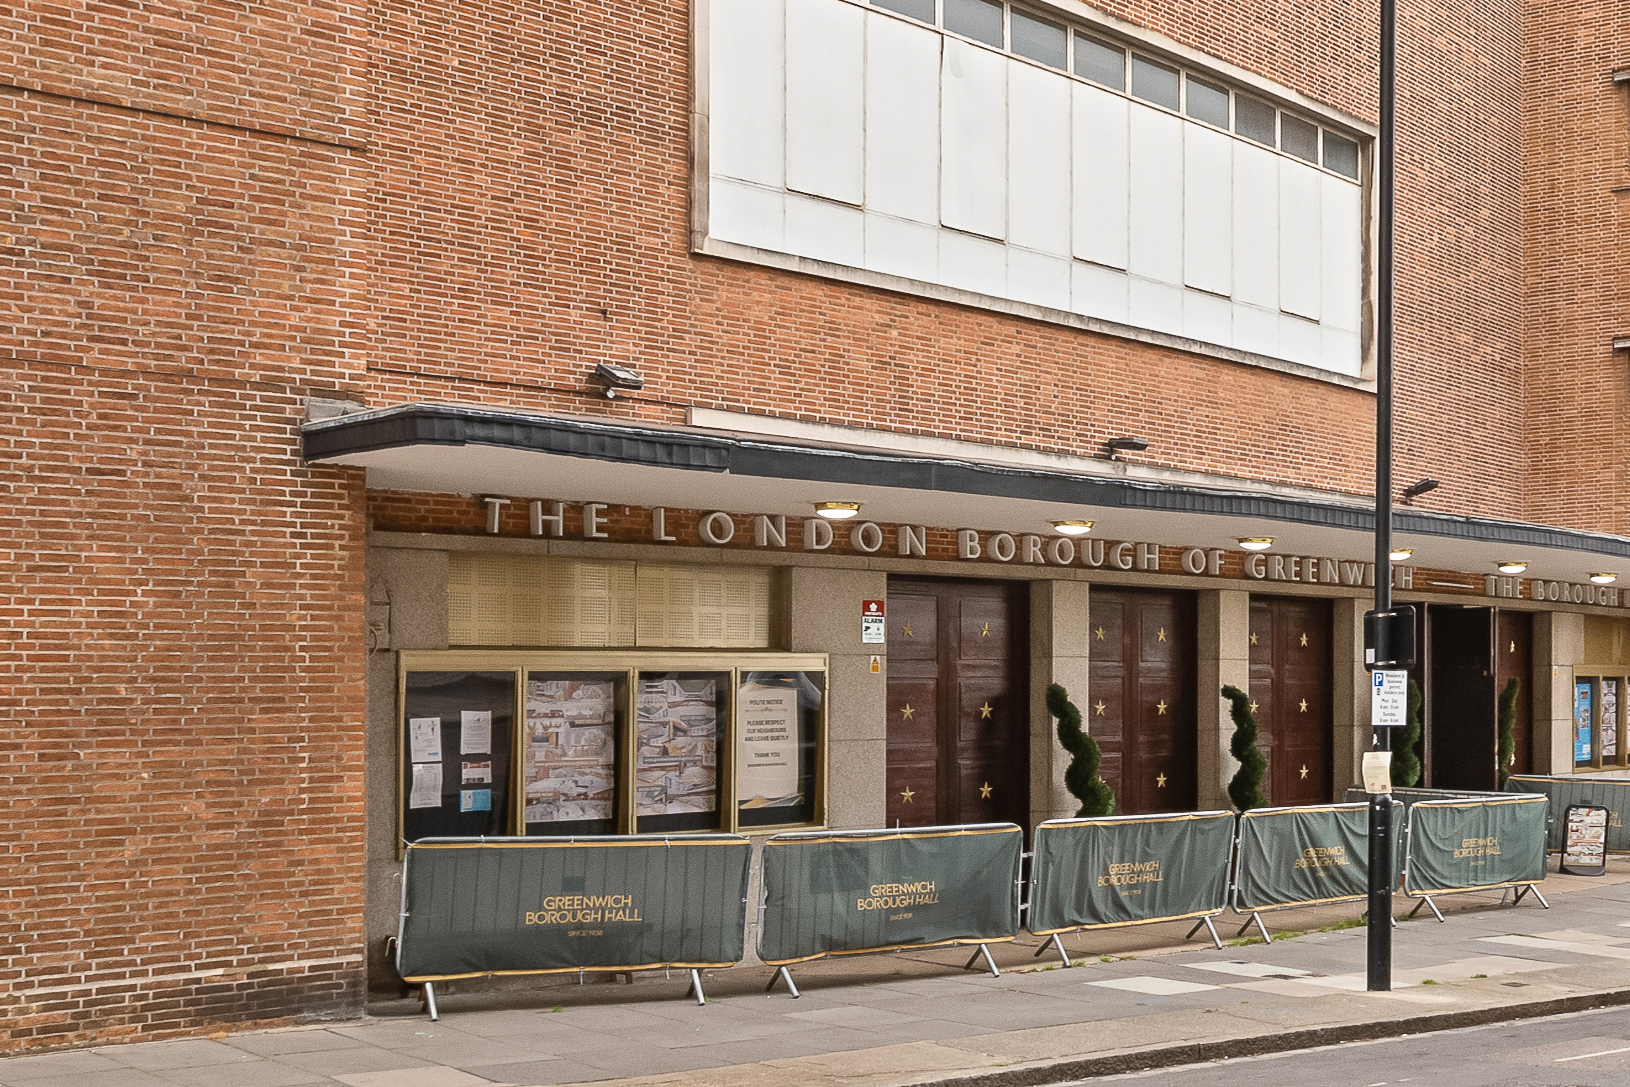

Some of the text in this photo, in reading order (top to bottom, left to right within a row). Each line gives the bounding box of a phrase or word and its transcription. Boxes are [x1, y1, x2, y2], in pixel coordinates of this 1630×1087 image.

[484, 497, 609, 539] THE
[652, 507, 927, 556] LONDON
[957, 529, 1160, 571] BOROUGH
[1180, 547, 1226, 576] OF
[1244, 553, 1413, 590] GREENWIH
[1485, 574, 1523, 598] THE
[1531, 580, 1619, 606] BOROUGH
[1376, 674, 1382, 685] P
[1453, 847, 1484, 859] BOROUGH
[1109, 860, 1160, 874] GREENWICH
[1097, 871, 1163, 887] BOROUGH HALL
[870, 881, 935, 897] GREENWICH
[543, 894, 632, 910] GREENWICH
[857, 893, 939, 911] BOROUGH HALL
[525, 908, 643, 925] BOROUGH HALL
